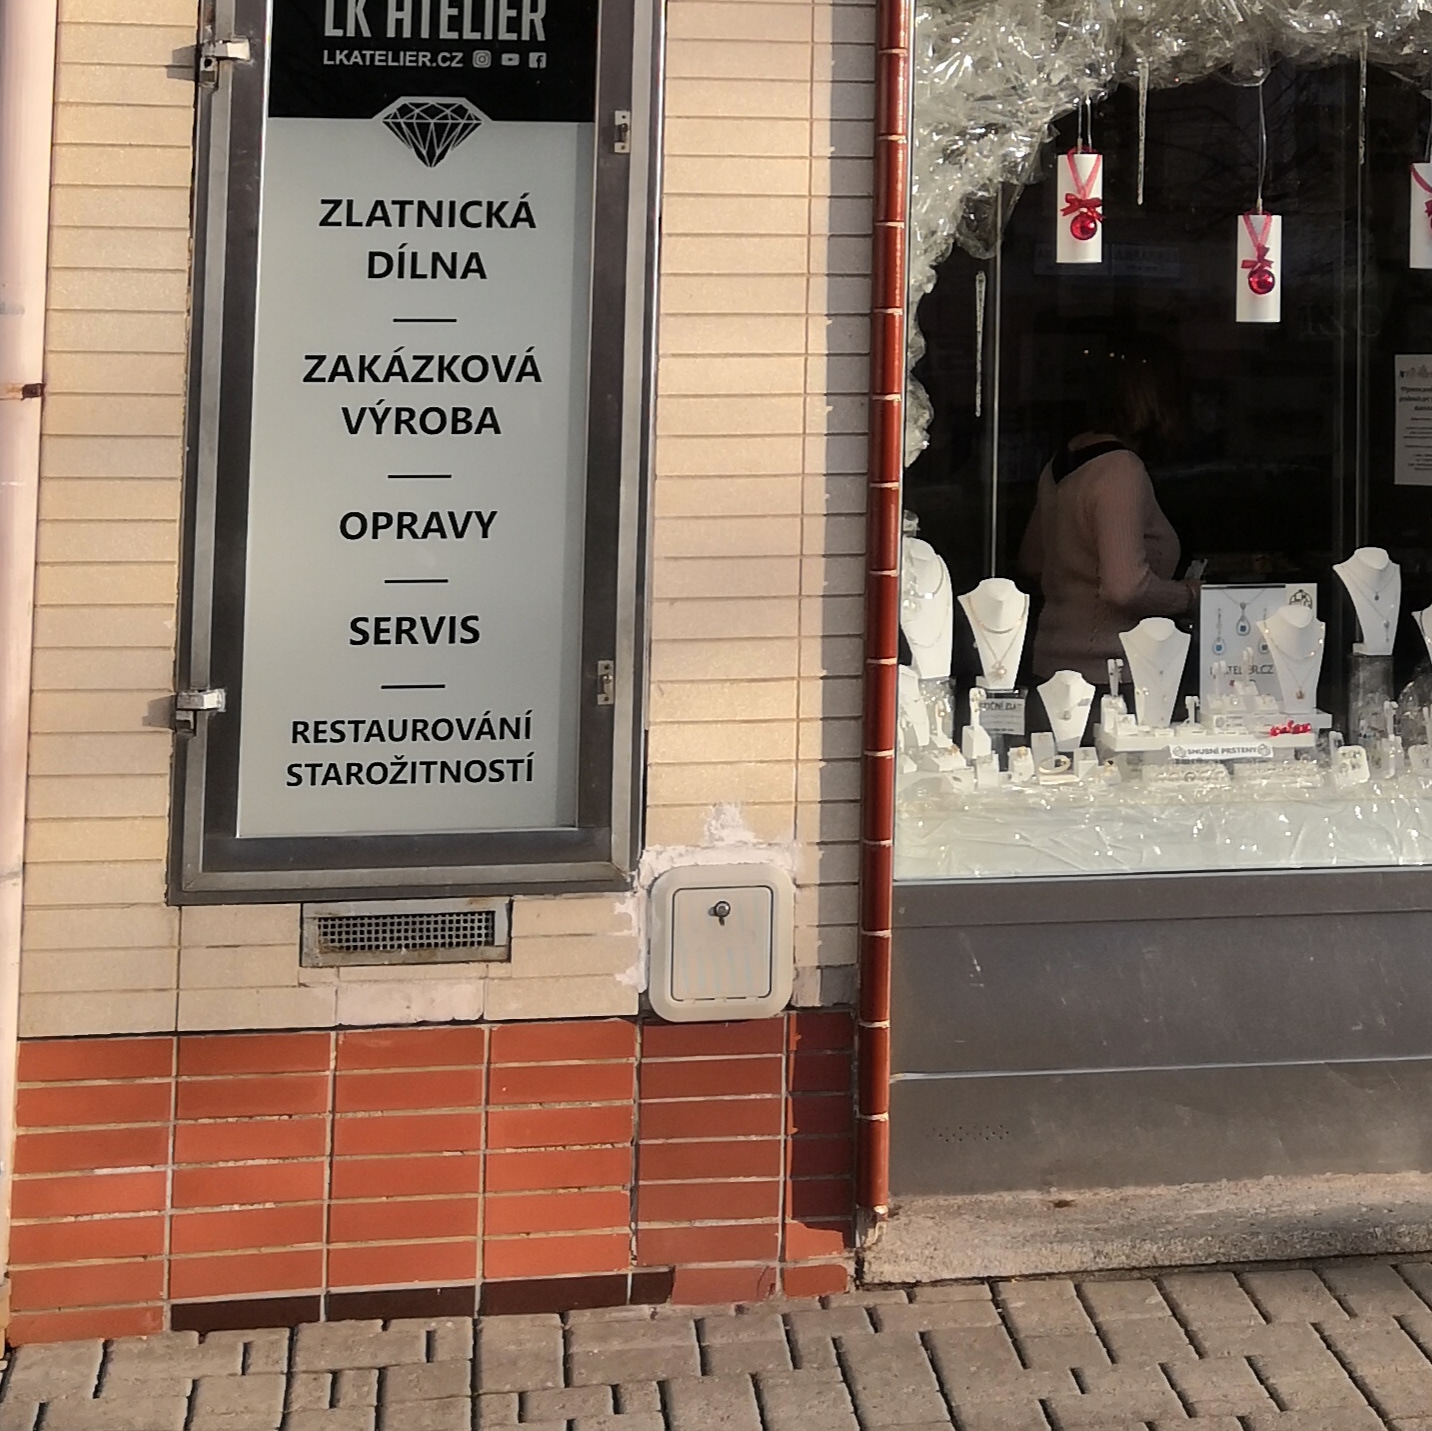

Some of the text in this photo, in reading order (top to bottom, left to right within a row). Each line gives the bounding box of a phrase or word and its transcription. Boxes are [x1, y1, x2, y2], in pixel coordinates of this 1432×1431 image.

[324, 50, 463, 67] LKATELIER.CZ
[319, 193, 536, 228] ZLATNICKÁ
[368, 243, 487, 279] DÍLNA
[303, 346, 542, 382] ZAKÁZKOVÁ
[342, 399, 501, 435] VÝROBA
[340, 511, 497, 540] OPRAVY
[350, 616, 479, 645] SERVIS
[292, 710, 532, 743] RESTAUROVÁNÍ
[287, 752, 534, 786] STAROŽITNOSTÍ
